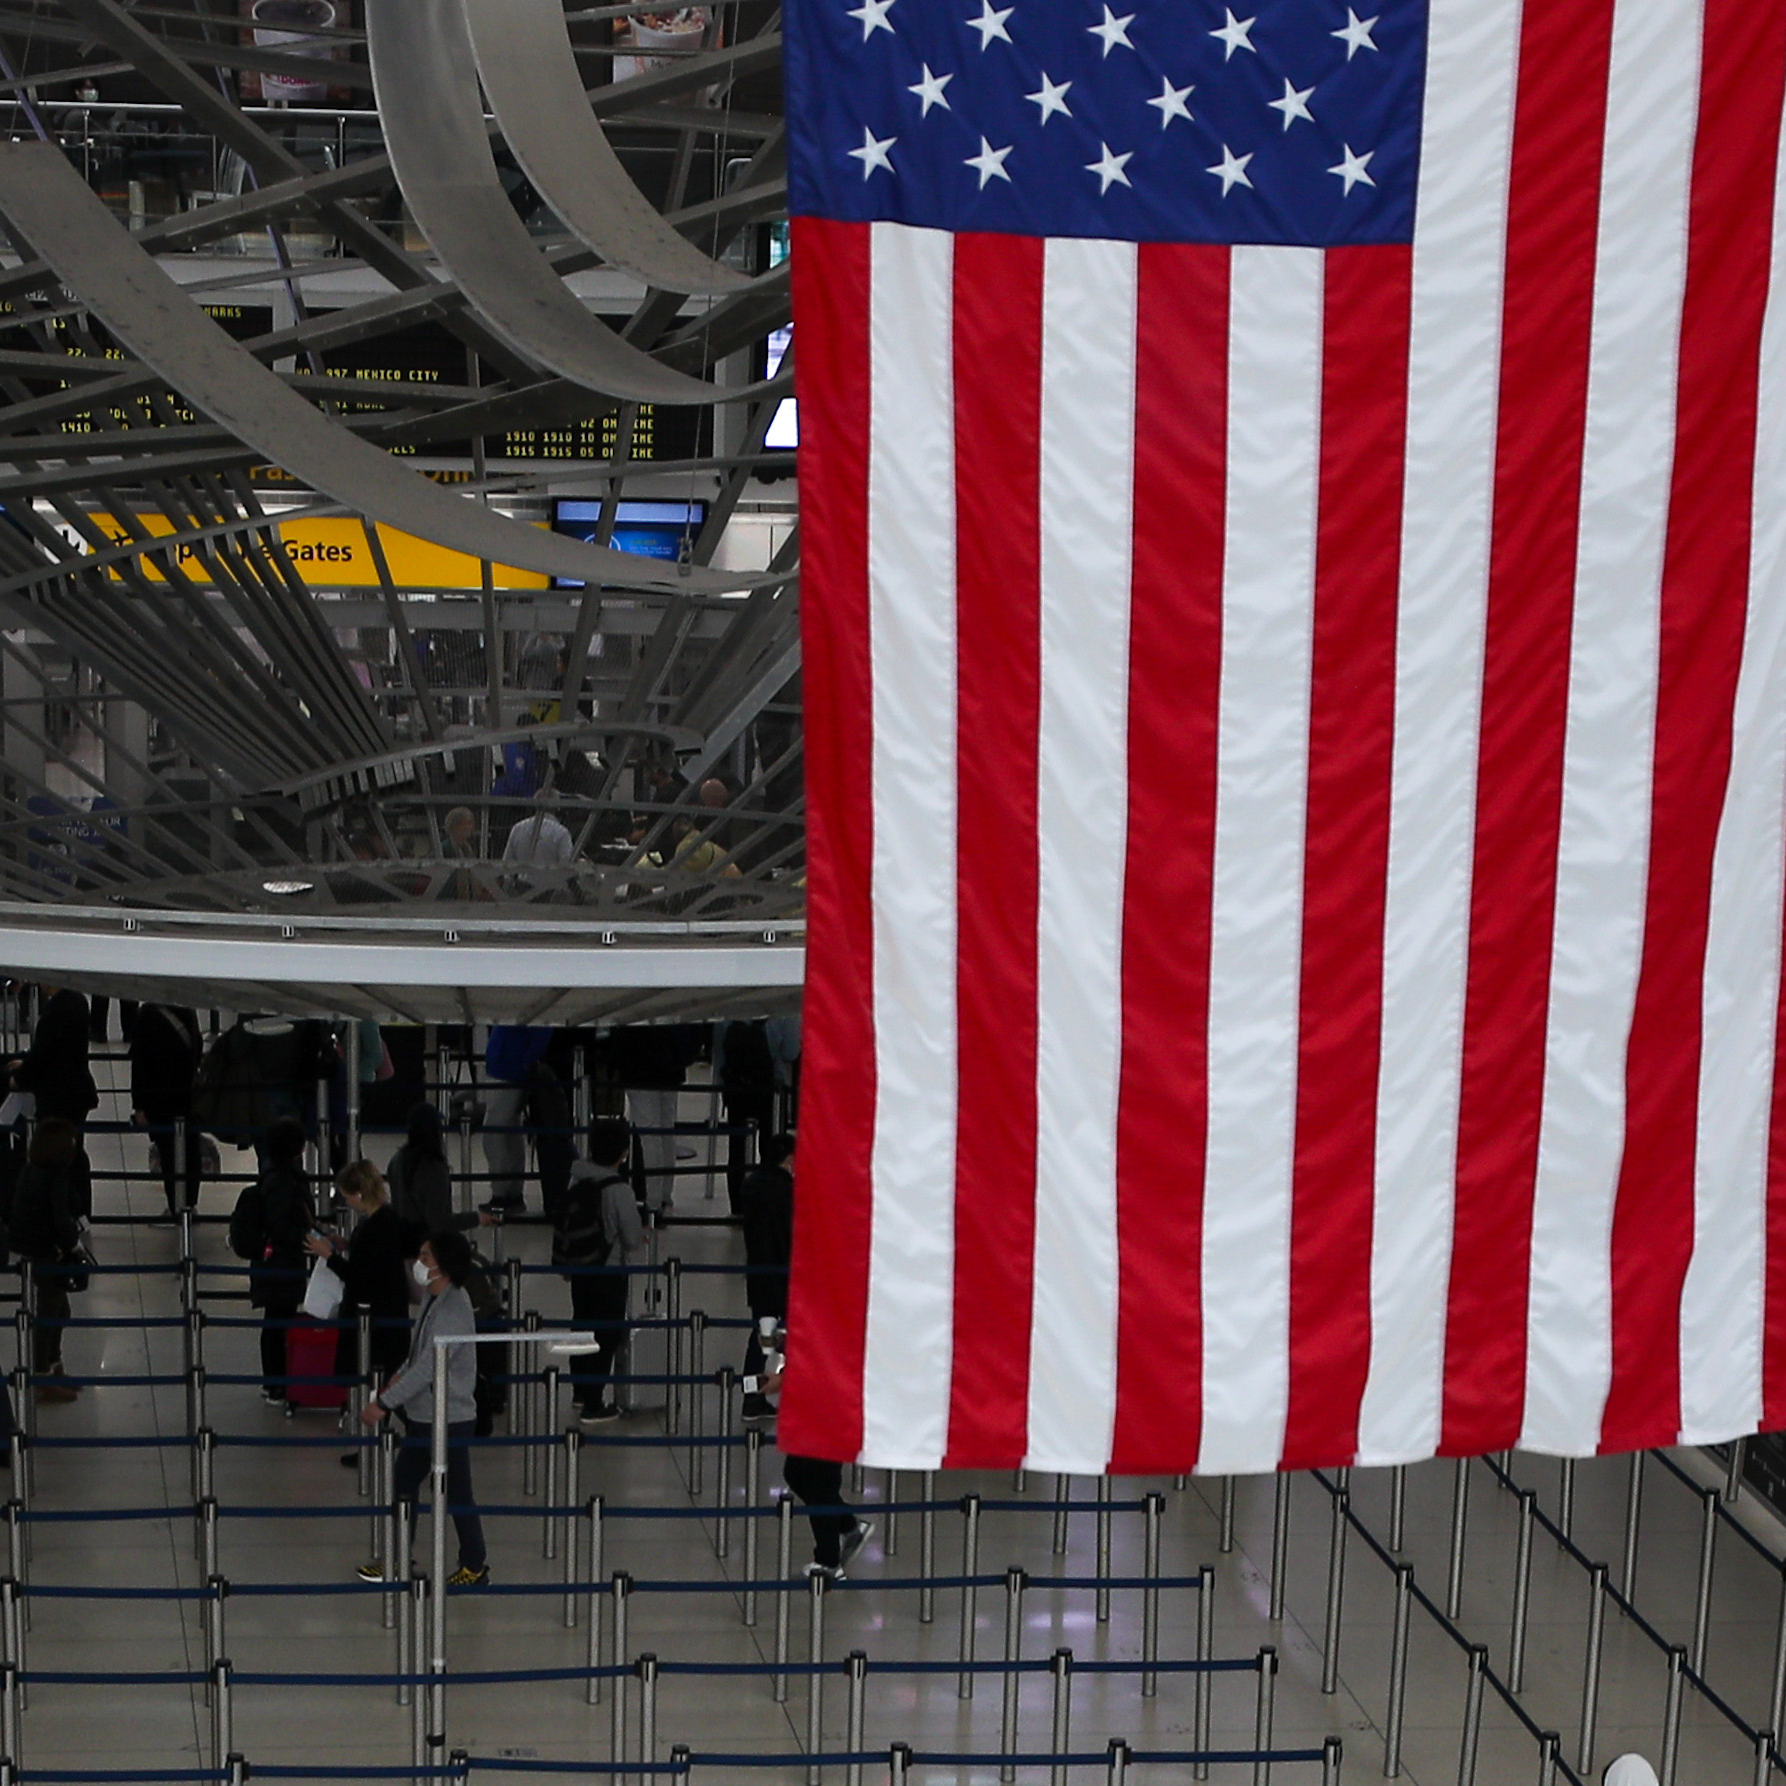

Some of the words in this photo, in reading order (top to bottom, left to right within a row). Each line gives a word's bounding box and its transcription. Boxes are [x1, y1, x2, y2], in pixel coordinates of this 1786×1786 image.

[408, 369, 439, 382] CITY
[505, 431, 536, 443] 1910
[543, 431, 573, 443] 1910
[580, 432, 595, 443] 10
[505, 445, 536, 457] 1915
[543, 446, 573, 457] 1915
[282, 540, 353, 562] Gates
